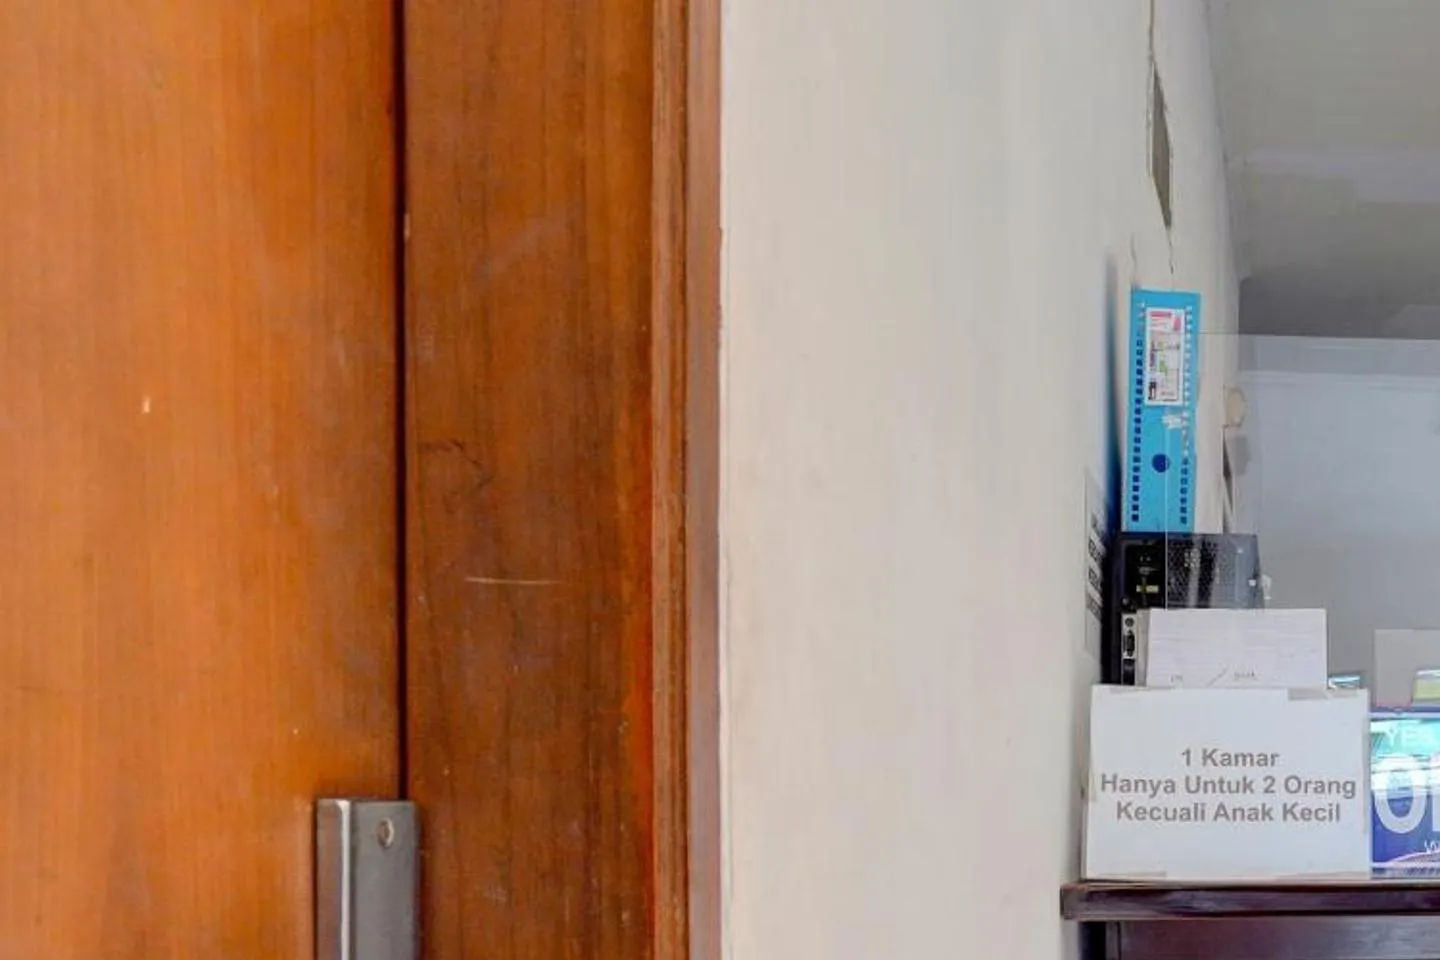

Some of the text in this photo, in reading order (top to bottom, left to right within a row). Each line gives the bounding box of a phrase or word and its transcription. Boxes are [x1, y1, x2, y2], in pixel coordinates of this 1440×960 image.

[1182, 749, 1279, 768] 1 Kamar
[1100, 774, 1357, 799] Hanya Untuk 2 Orang
[1117, 801, 1341, 822] Kecuali Anak Kecil
